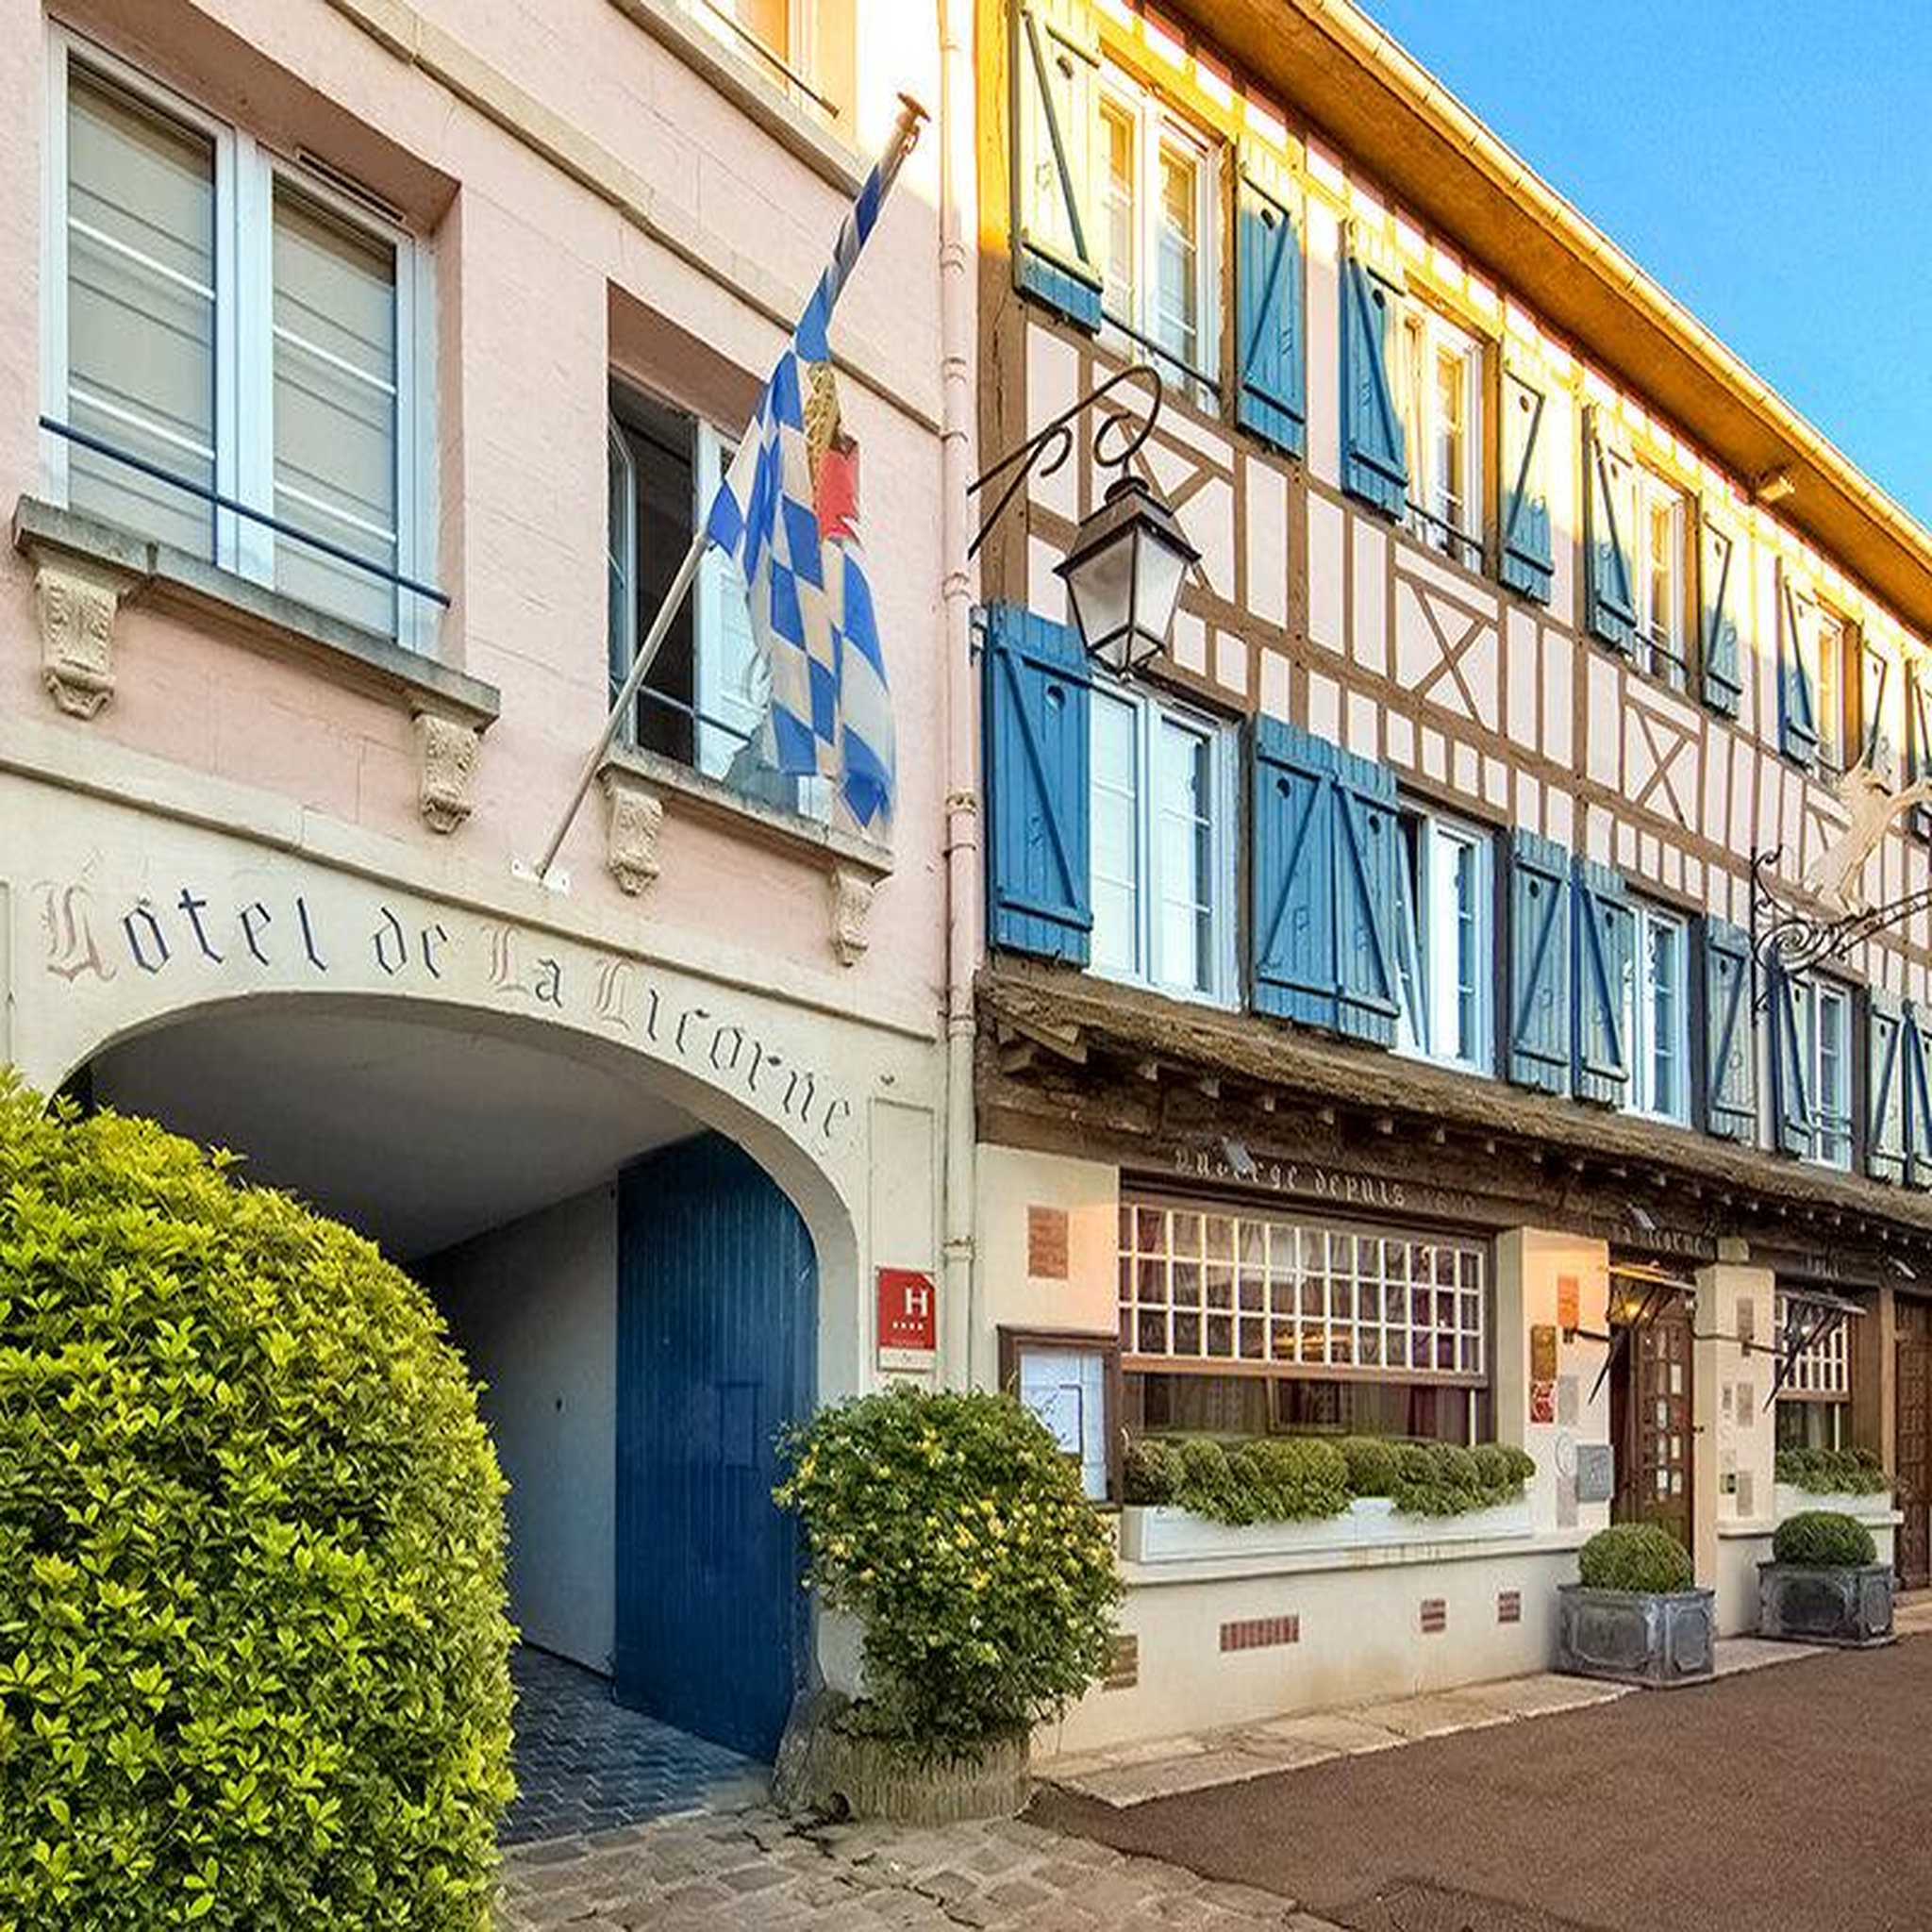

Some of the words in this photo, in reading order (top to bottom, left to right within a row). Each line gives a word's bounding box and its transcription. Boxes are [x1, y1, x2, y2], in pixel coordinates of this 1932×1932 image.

[375, 907, 448, 979] de
[479, 923, 563, 1009] La
[594, 955, 851, 1138] Licorne
[906, 1286, 927, 1317] H
